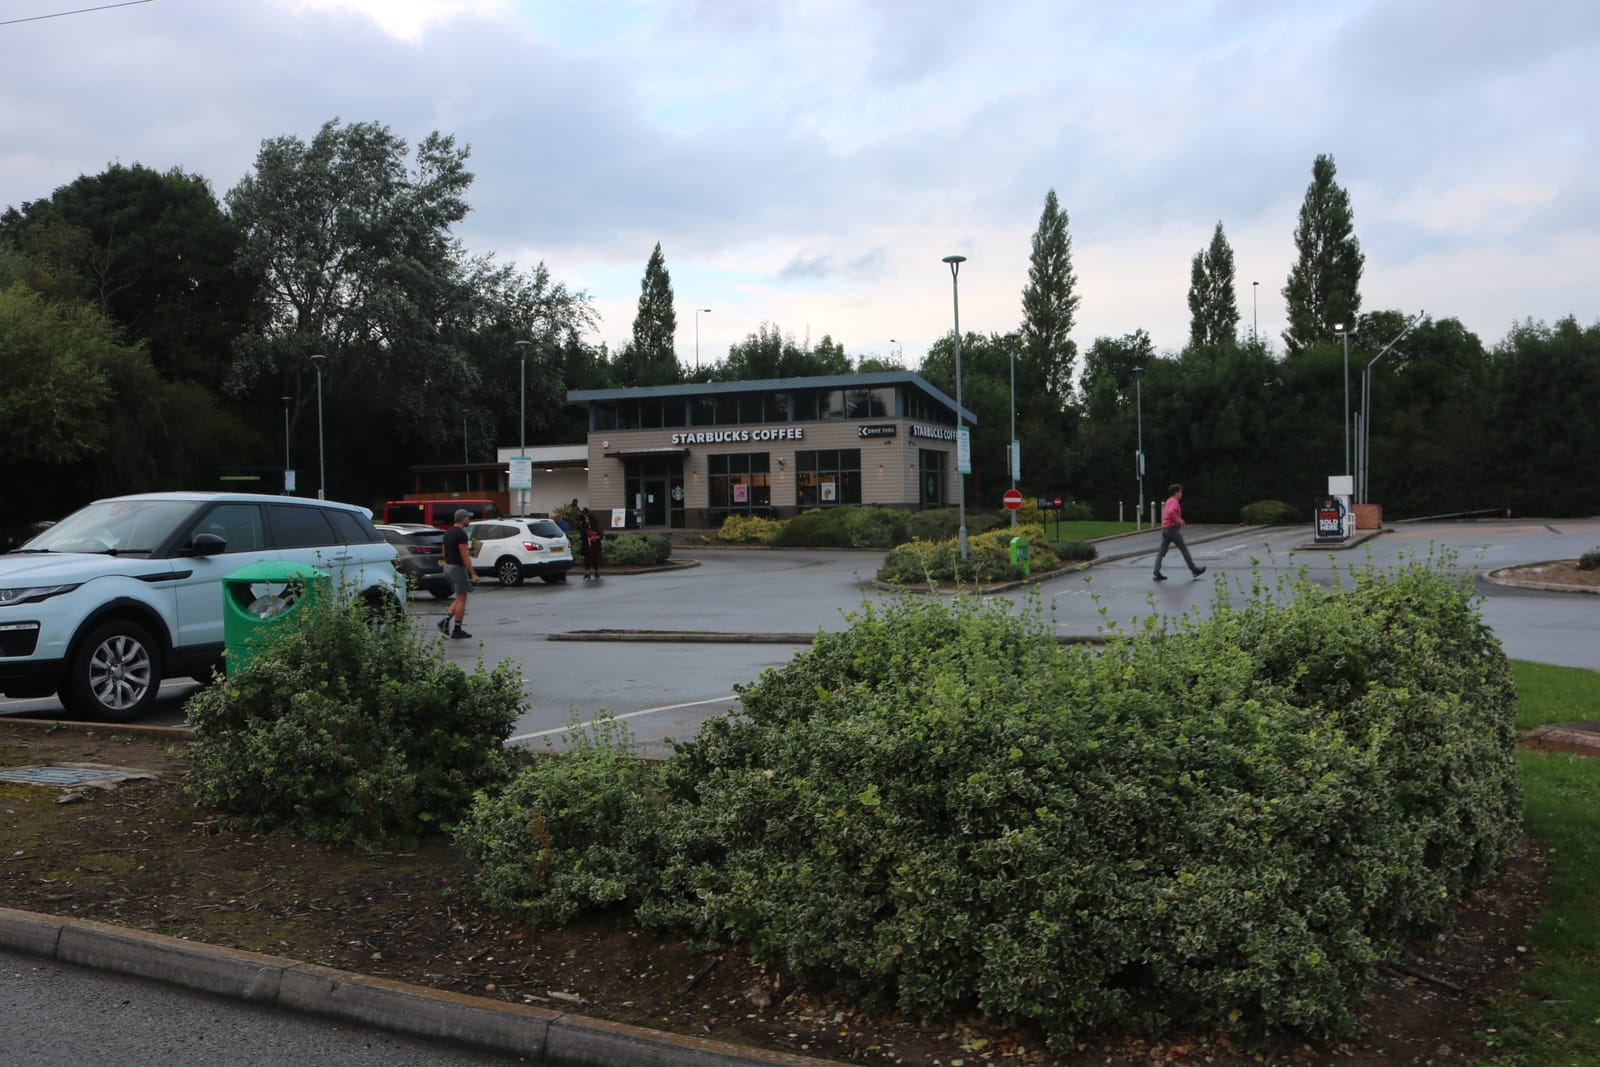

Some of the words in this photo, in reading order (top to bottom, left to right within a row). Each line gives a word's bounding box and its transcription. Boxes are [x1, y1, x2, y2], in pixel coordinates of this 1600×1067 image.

[671, 430, 749, 444] STARBUCKS
[752, 428, 803, 441] COFFEE
[913, 425, 943, 439] STARBUCKS
